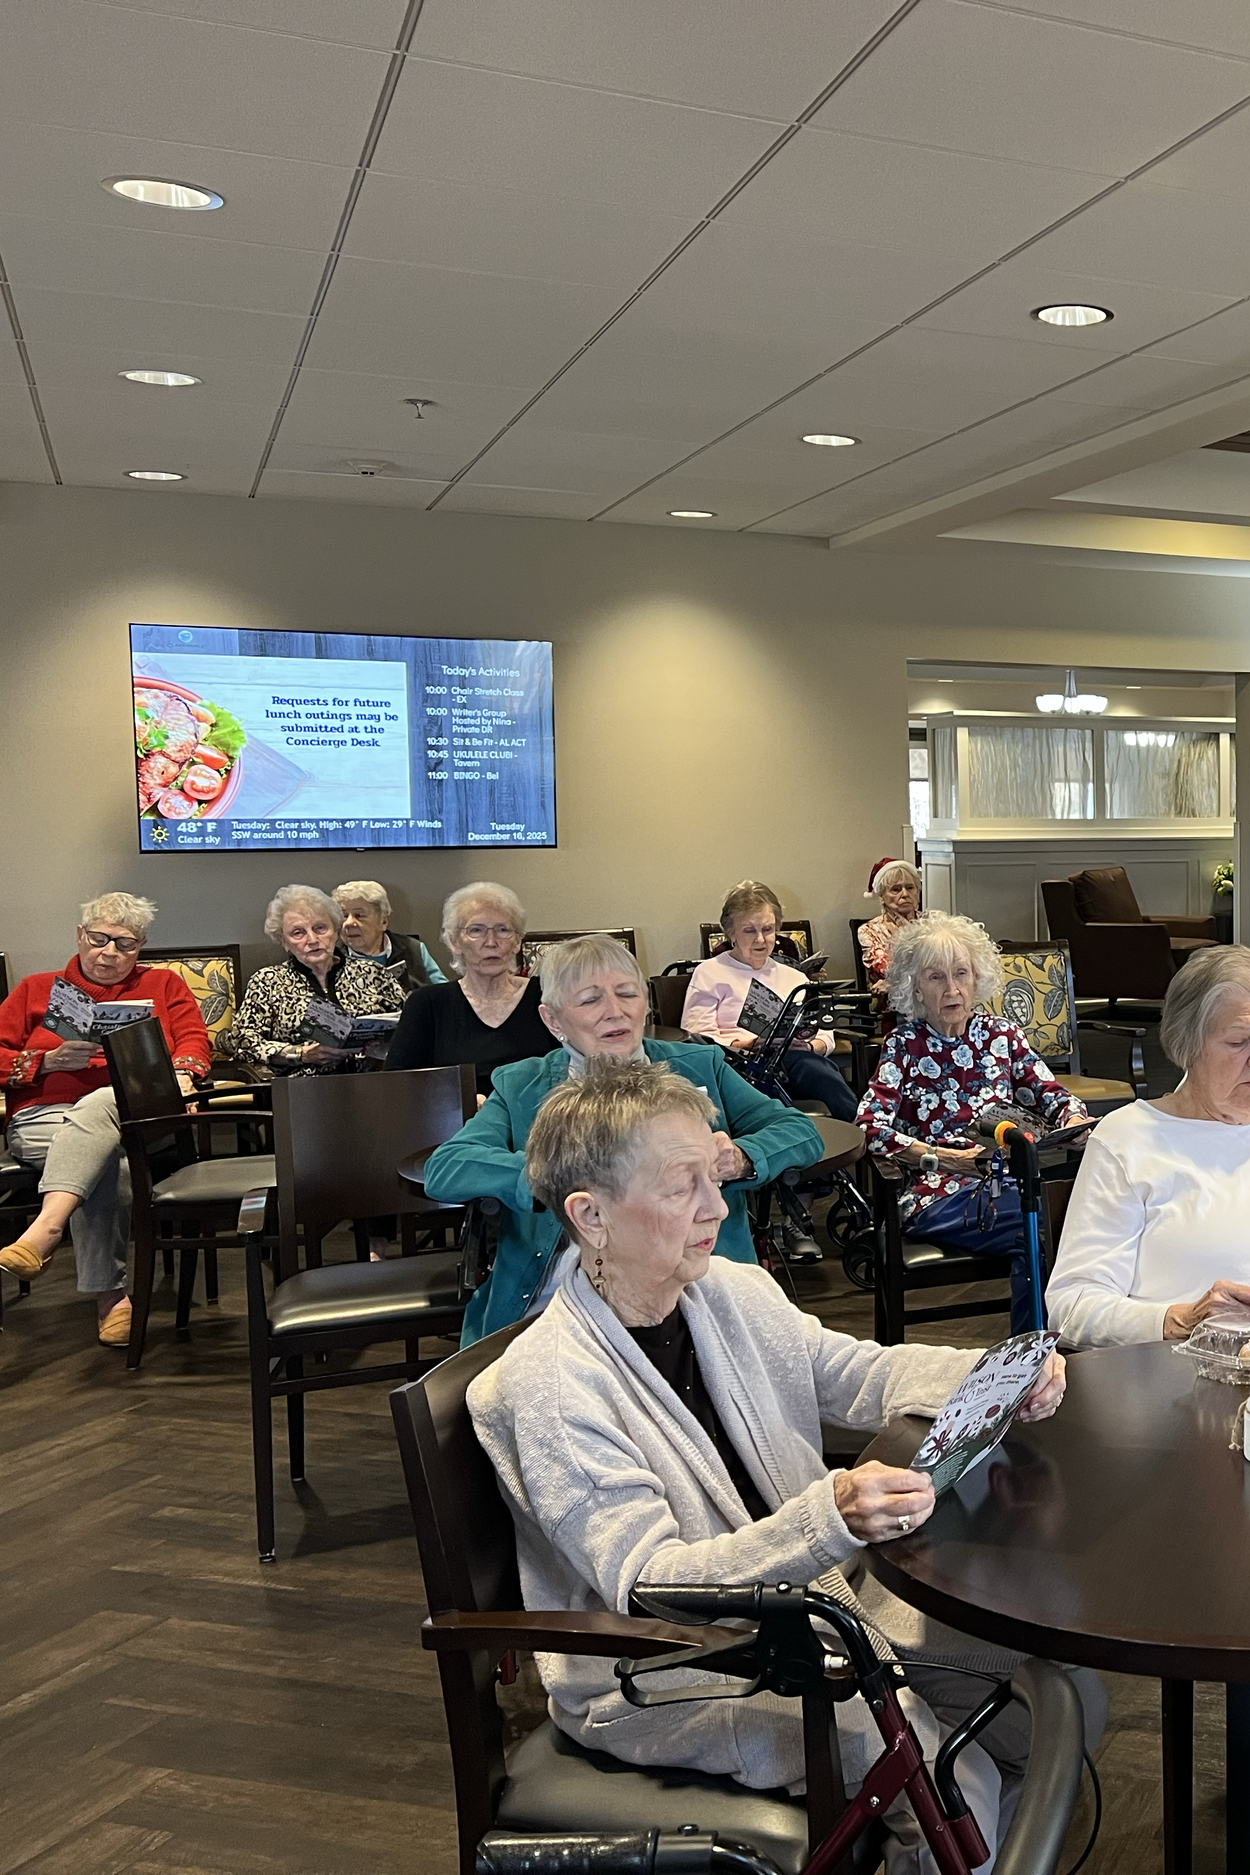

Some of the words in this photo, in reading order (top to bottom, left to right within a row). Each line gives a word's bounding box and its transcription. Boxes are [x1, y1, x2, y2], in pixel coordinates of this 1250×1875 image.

[441, 665, 477, 678] Today's
[478, 666, 520, 678] Activities
[425, 686, 447, 695] 10:00
[451, 686, 473, 696] Chair
[474, 687, 502, 696] Stretch
[503, 688, 525, 697] Class
[271, 695, 329, 708] Requests
[332, 697, 350, 707] for
[353, 697, 392, 708] future
[456, 696, 467, 704] EX
[264, 709, 302, 720] lunch
[305, 710, 353, 722] outings
[355, 713, 381, 723] may
[384, 712, 399, 722] be
[425, 707, 448, 716] 10:00
[451, 708, 482, 717] Writer's
[482, 709, 507, 719] Group
[452, 716, 480, 725] Hosted
[481, 717, 492, 727] by
[492, 717, 511, 726] Nina
[280, 723, 345, 734] submitted
[347, 725, 361, 734] at
[363, 724, 385, 734] the
[452, 725, 480, 734] Private
[481, 725, 493, 734] DR
[285, 736, 348, 749] Concierge
[426, 737, 449, 746] 10:30
[464, 738, 471, 746] &
[471, 738, 483, 746] Be
[483, 738, 493, 746] Fit
[499, 738, 510, 747] AL
[510, 738, 527, 747] ACT
[427, 750, 449, 759] 10:45
[453, 750, 489, 759] UKULELE
[453, 759, 480, 767] Tavern
[427, 771, 449, 780] 11:00
[453, 771, 480, 780] BINGO
[207, 822, 217, 833] F
[230, 820, 270, 832] Tuesday:
[275, 820, 299, 830] Clear
[319, 820, 342, 831] High:
[362, 820, 368, 829] F
[370, 820, 390, 829] Low:
[409, 820, 415, 828] F
[416, 819, 442, 829] Winds
[489, 821, 526, 833] Tuesday
[177, 835, 203, 844] Clear
[205, 835, 221, 845] sky
[231, 831, 252, 840] SSW
[252, 831, 284, 840] around
[286, 831, 298, 840] 10
[299, 830, 319, 841] mph
[468, 832, 511, 841] December
[526, 831, 548, 841] 2025
